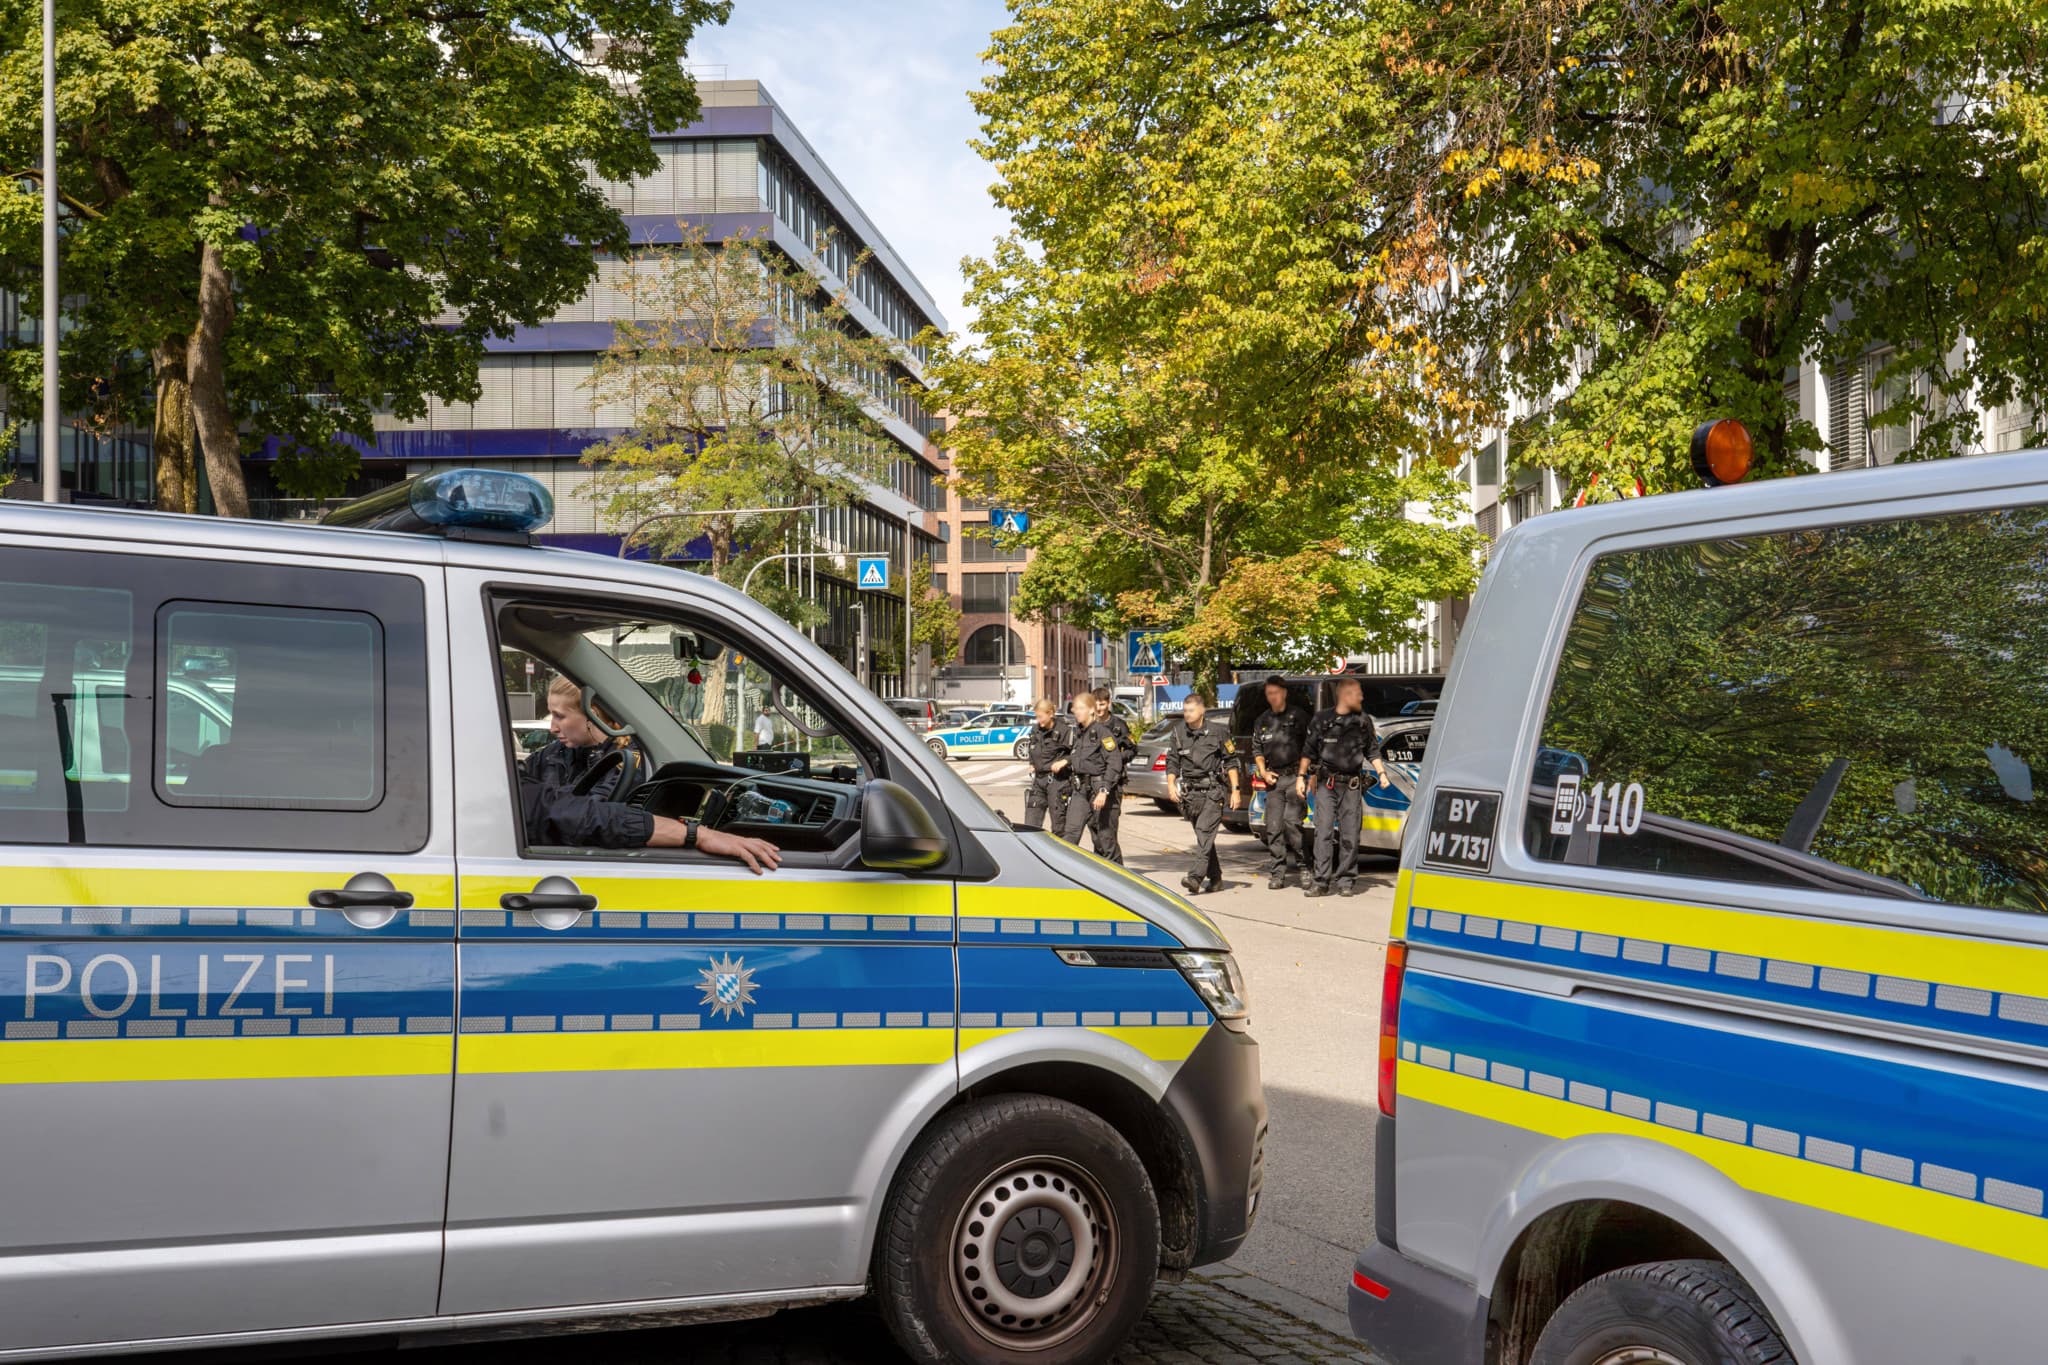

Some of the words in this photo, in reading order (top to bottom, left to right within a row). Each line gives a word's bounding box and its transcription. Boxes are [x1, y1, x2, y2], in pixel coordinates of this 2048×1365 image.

[1160, 701, 1184, 710] ZUKU
[1397, 751, 1413, 760] 110
[1449, 798, 1480, 823] BY
[1586, 781, 1643, 835] 110
[1428, 831, 1446, 855] M
[1448, 833, 1490, 862] 7131
[25, 953, 334, 1019] POLIZEI
